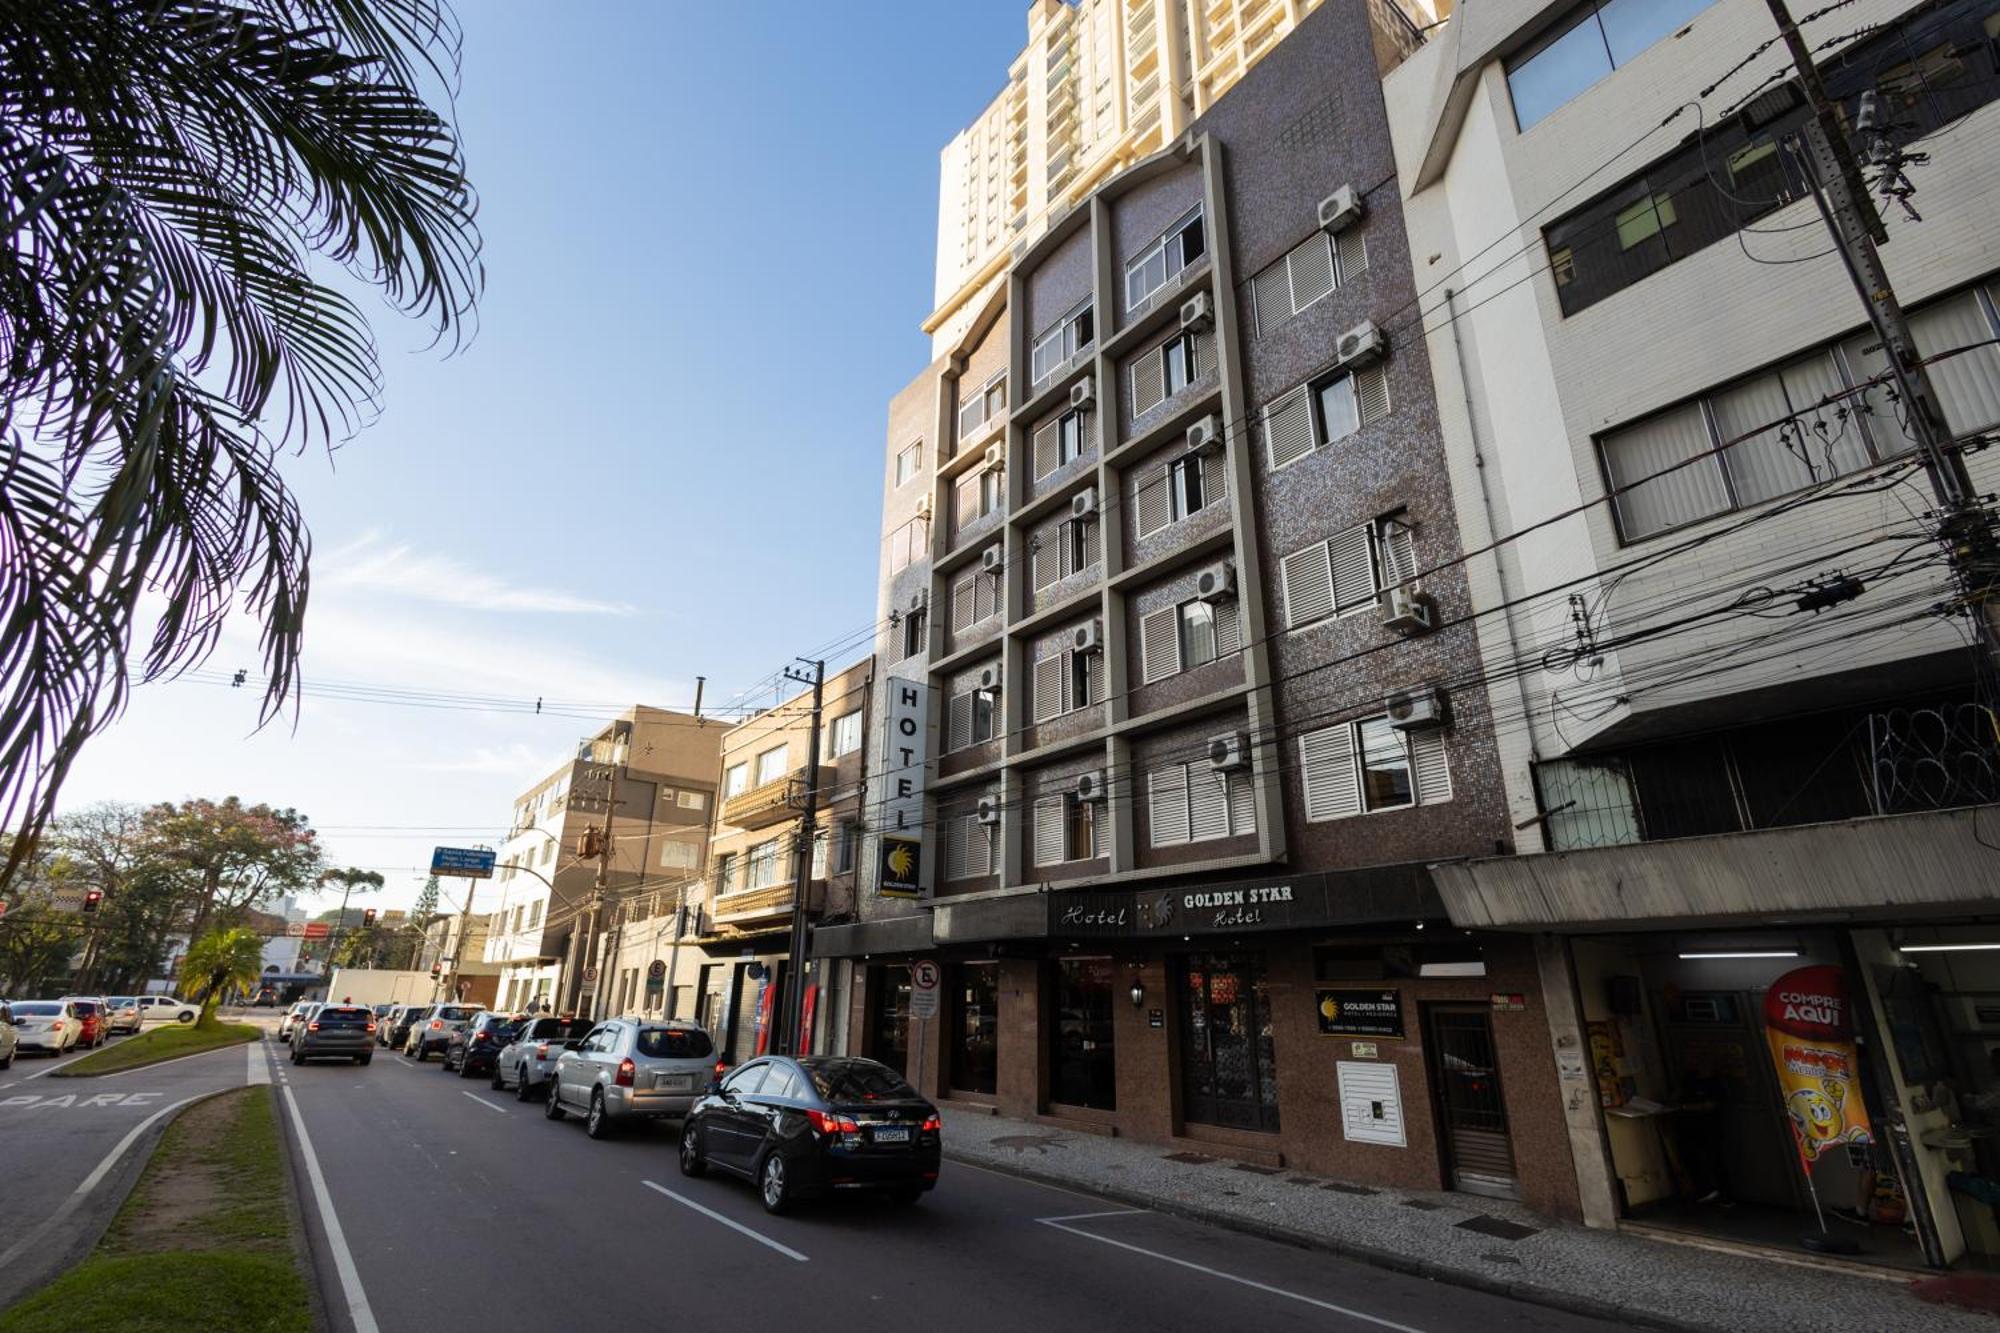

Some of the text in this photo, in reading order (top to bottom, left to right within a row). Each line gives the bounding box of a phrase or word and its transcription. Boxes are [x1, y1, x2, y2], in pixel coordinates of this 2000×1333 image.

[898, 687, 918, 830] HOTEL
[1184, 886, 1293, 909] GOLDEN STAR
[1061, 905, 1128, 926] Hotel
[1212, 907, 1262, 928] Hotel
[1343, 1002, 1396, 1011] GOLDEN STAR
[1779, 992, 1843, 1010] COMPRE
[1784, 1005, 1840, 1026] AQUI
[0, 1092, 163, 1109] PARE
